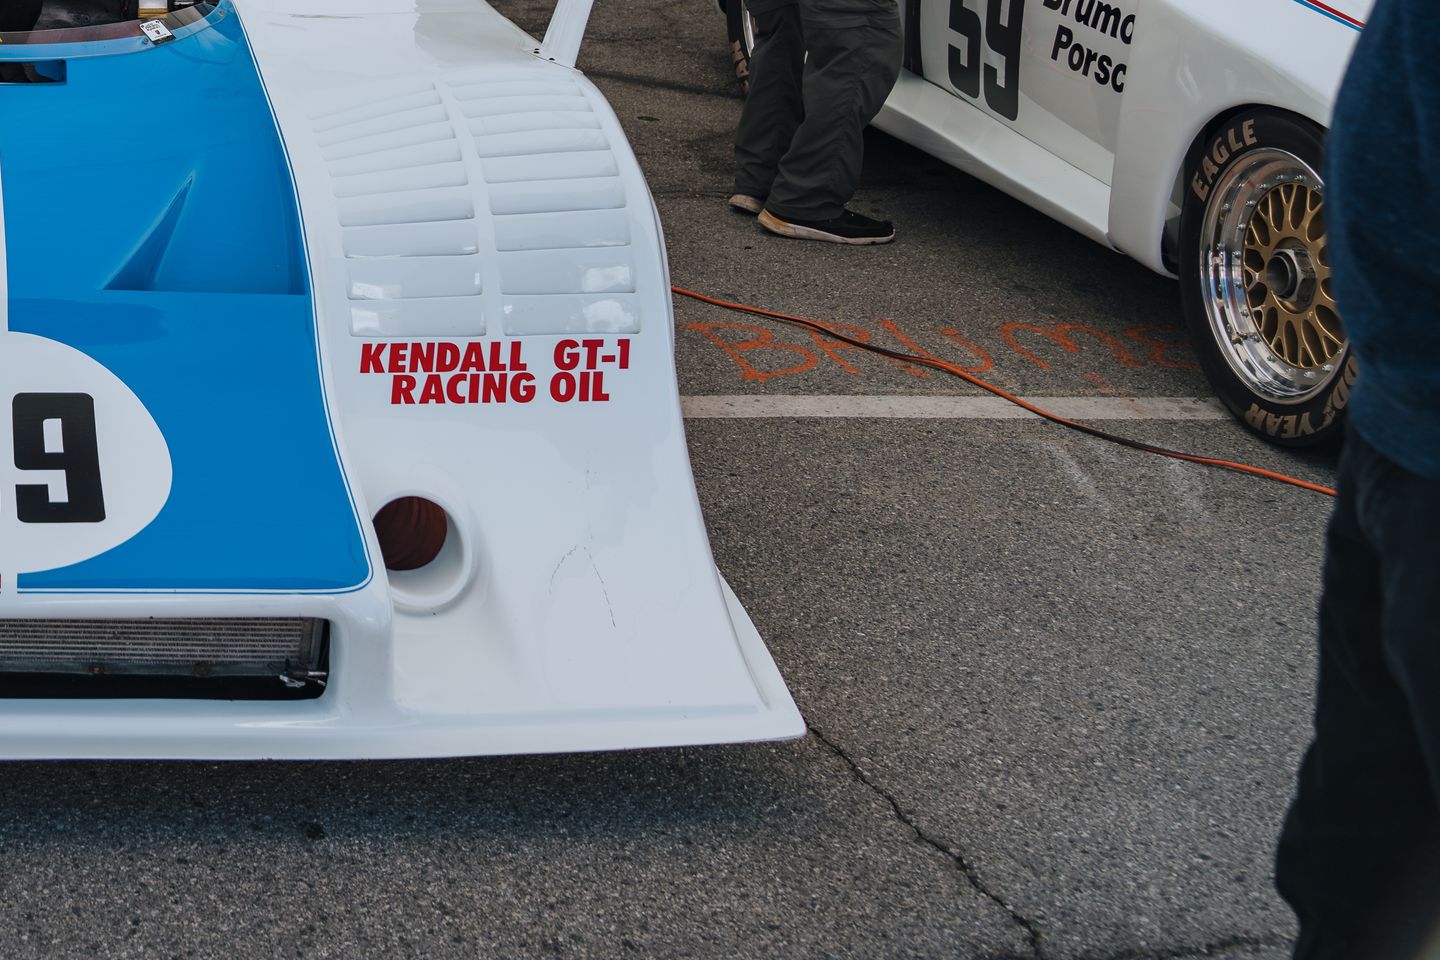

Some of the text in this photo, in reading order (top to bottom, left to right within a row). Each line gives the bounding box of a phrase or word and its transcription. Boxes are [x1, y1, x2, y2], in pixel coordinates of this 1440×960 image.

[1191, 118, 1257, 202] EAGLE
[359, 338, 630, 374] KENDALL GT-1
[390, 371, 610, 404] RACING OIL
